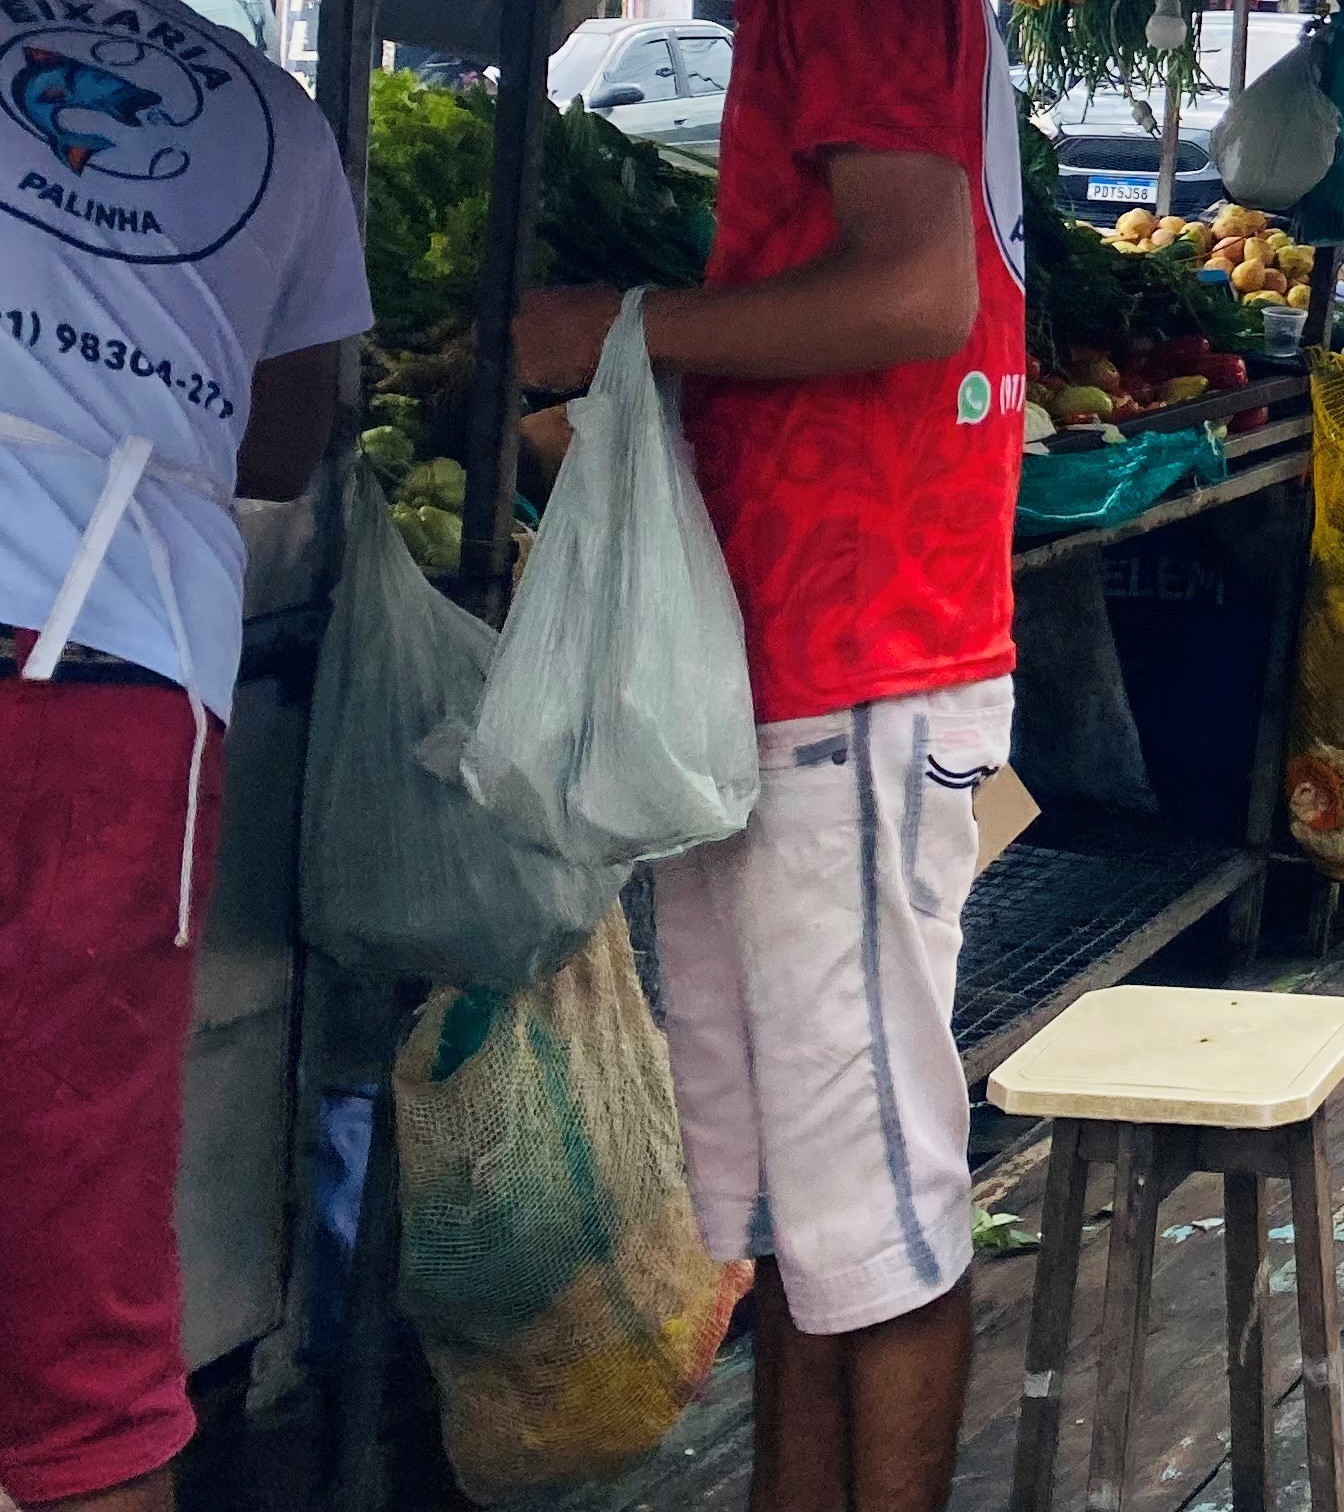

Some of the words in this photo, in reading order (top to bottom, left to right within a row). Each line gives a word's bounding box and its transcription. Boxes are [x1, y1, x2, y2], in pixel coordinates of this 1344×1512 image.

[17, 172, 163, 235] PALINHA
[0, 310, 41, 347] 1)
[1097, 555, 1226, 608] ELEM
